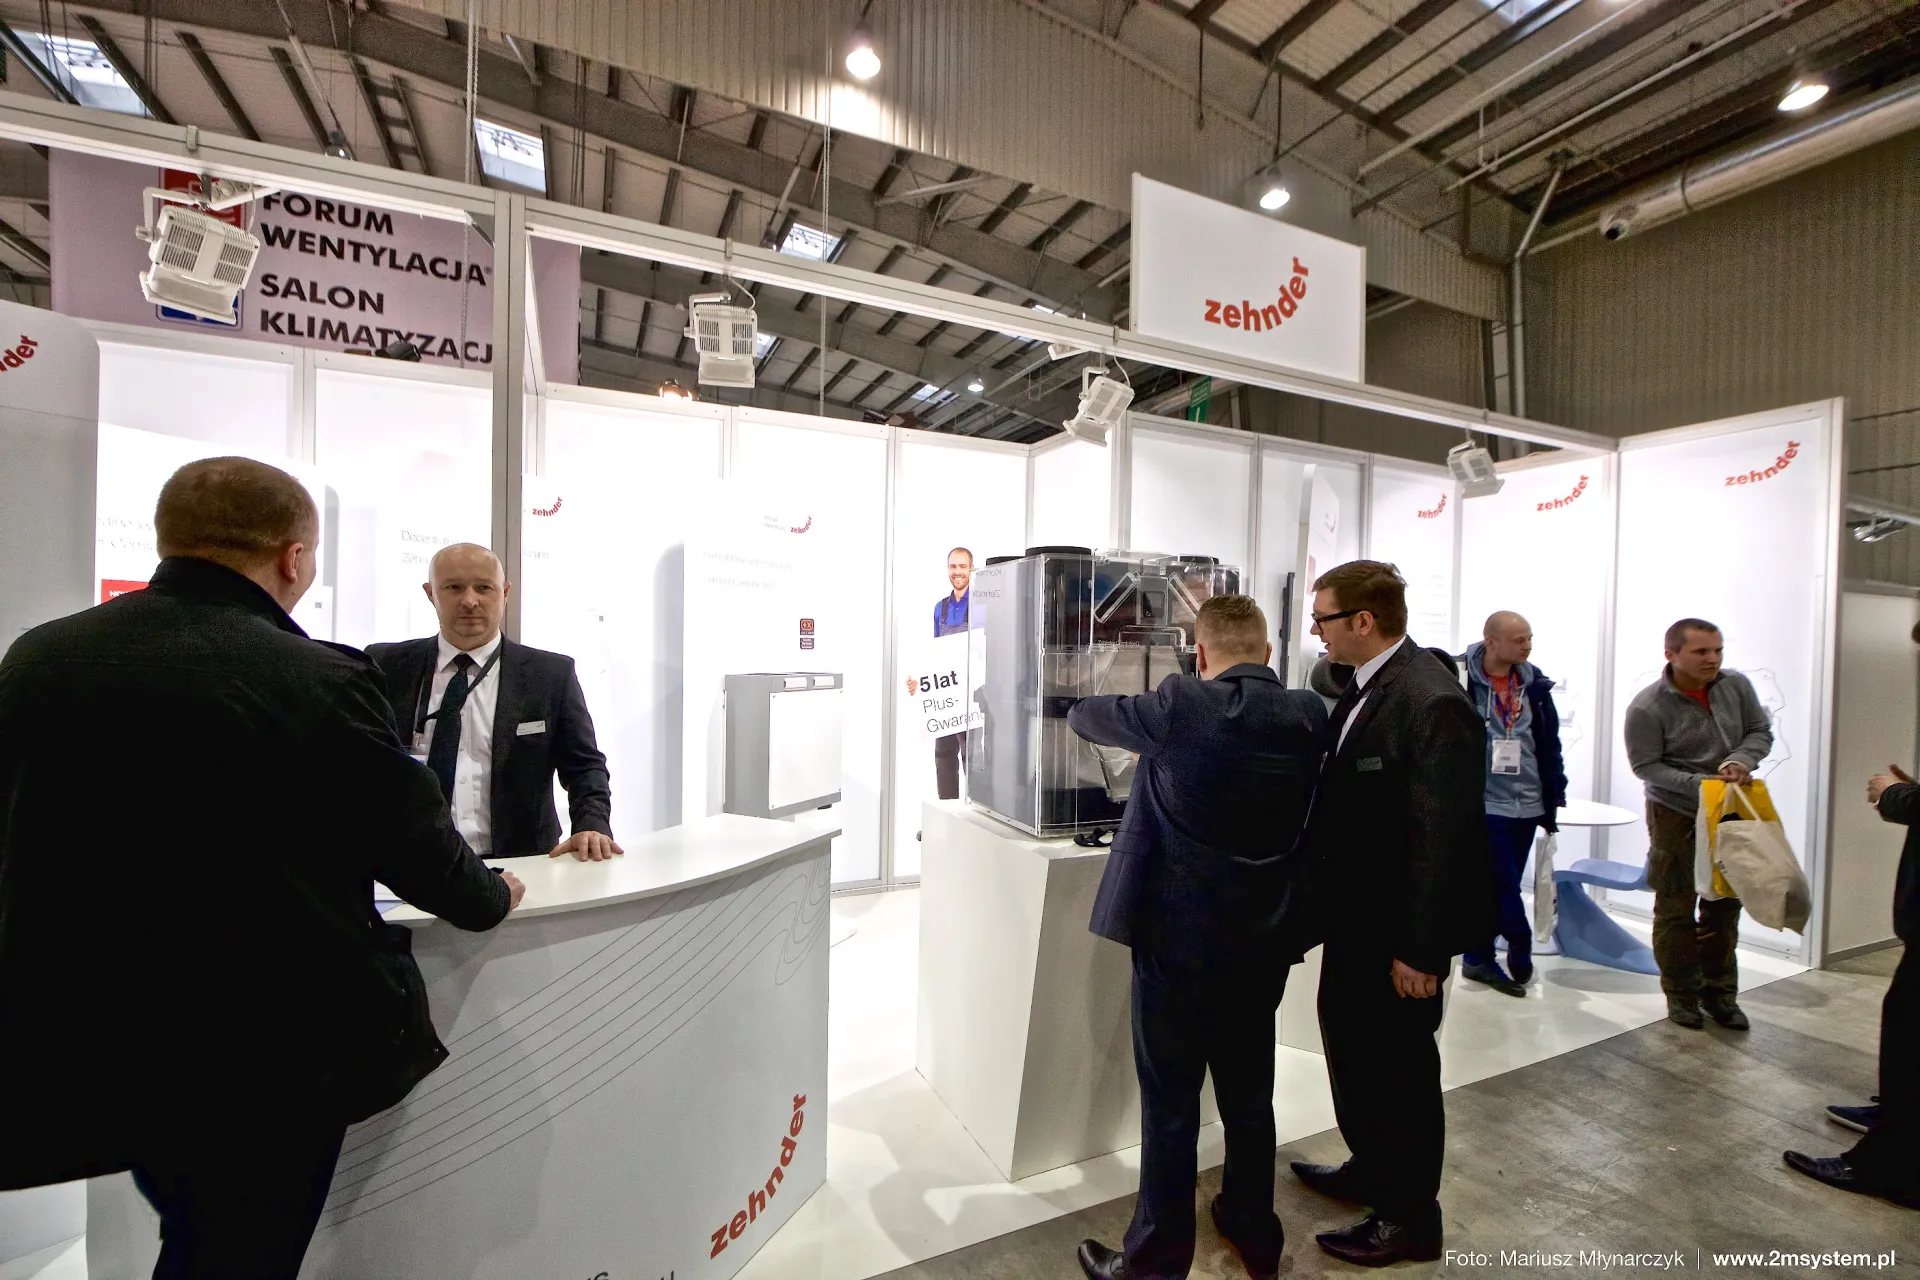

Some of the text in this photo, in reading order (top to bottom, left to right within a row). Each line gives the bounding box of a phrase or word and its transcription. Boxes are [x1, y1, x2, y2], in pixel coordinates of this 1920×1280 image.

[262, 190, 395, 236] FORUM
[259, 272, 385, 315] SALON
[1204, 256, 1310, 334] zehnder
[0, 334, 38, 372] der
[1726, 440, 1801, 487] zehnder
[531, 495, 564, 518] zehnder
[1417, 493, 1448, 519] zehnder
[1536, 474, 1590, 513] zehnder
[790, 515, 812, 534] zehnder
[920, 670, 959, 693] 5 lat
[922, 697, 960, 714] Plus-
[711, 1094, 807, 1259] zehnder
